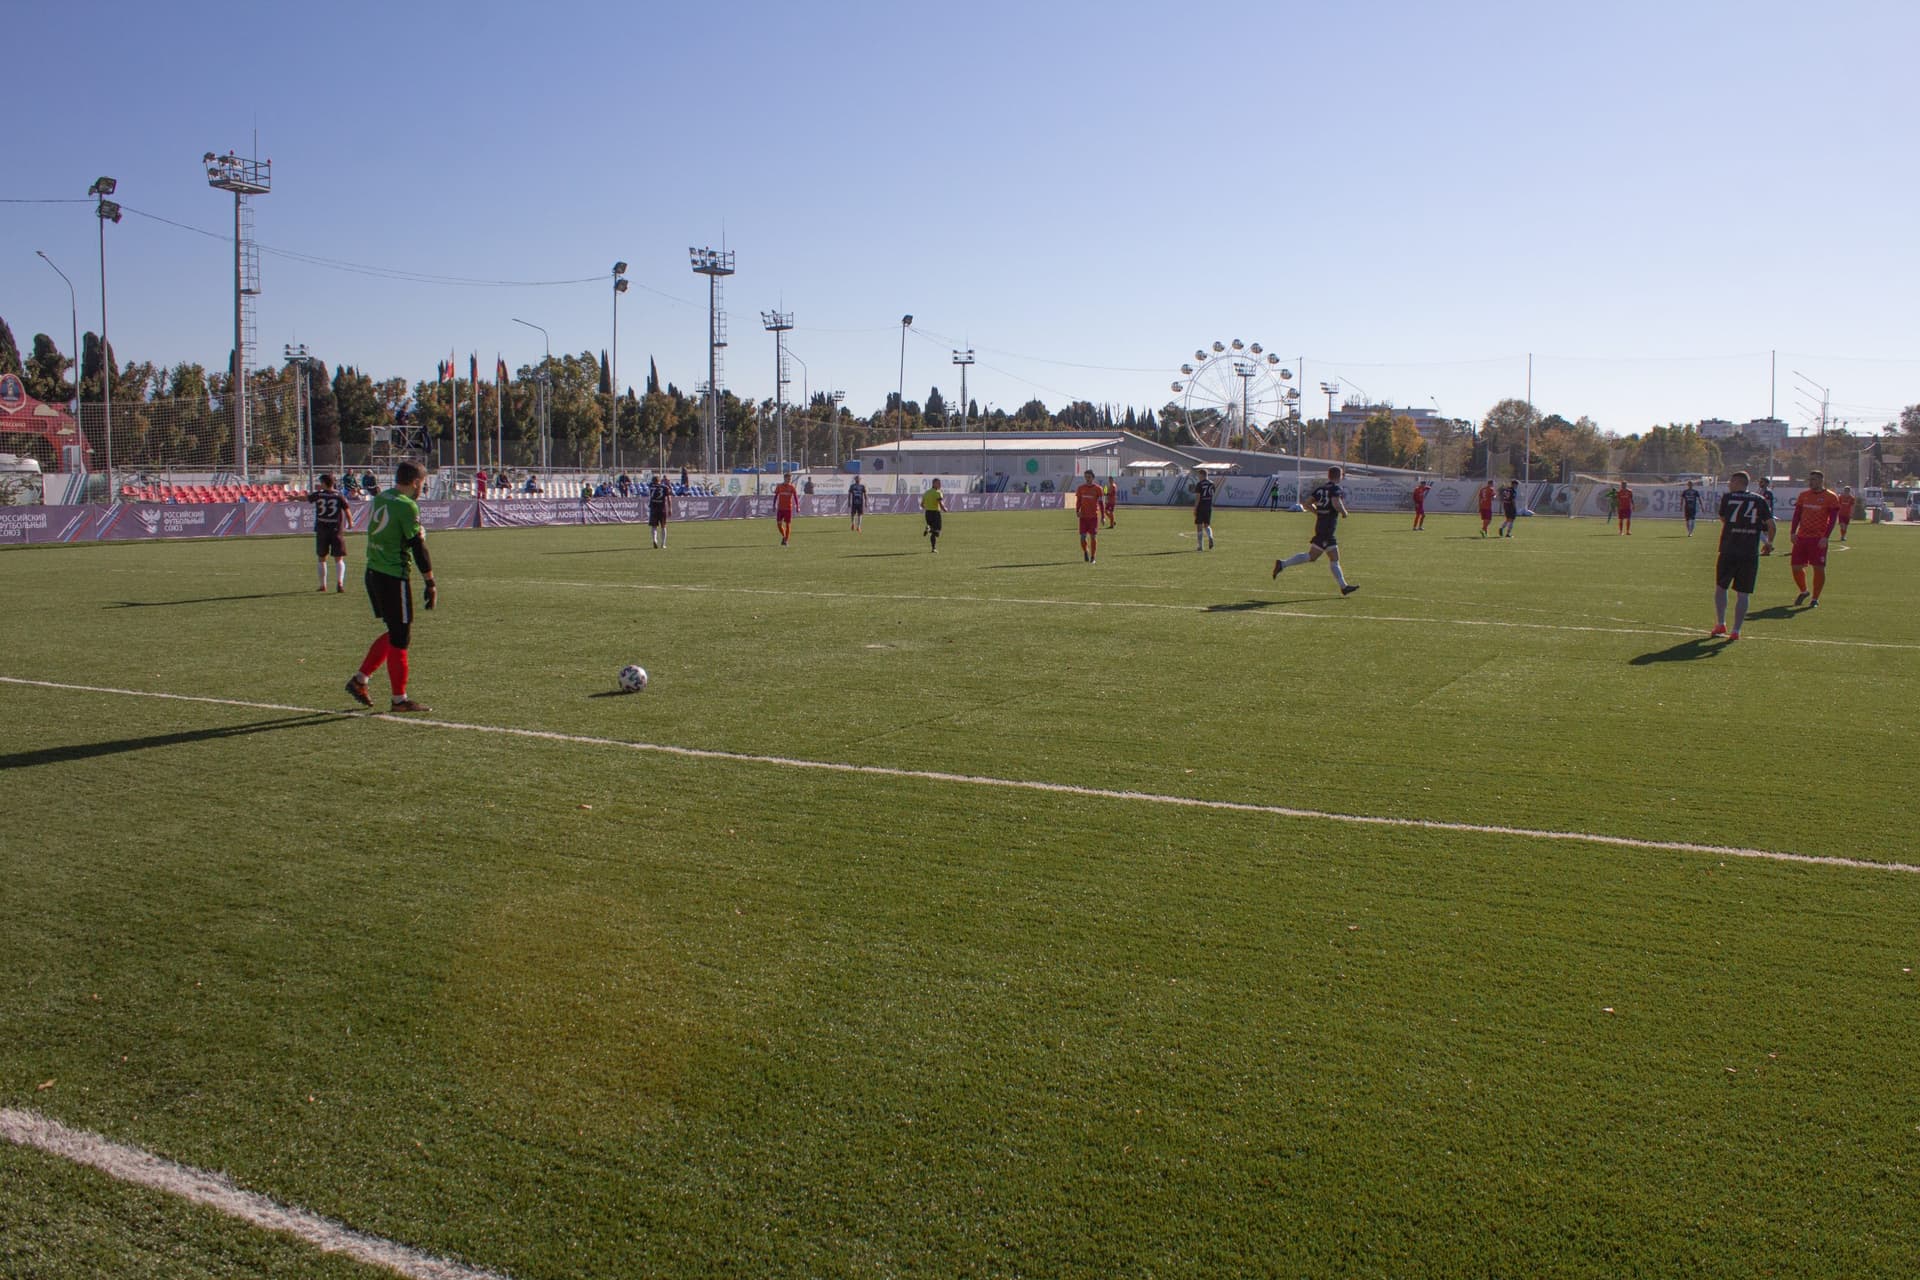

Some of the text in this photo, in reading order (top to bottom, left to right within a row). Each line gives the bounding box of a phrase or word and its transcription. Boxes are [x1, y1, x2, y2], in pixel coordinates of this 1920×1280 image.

[317, 498, 338, 517] 33
[1652, 488, 1665, 512] 3
[0, 513, 47, 521] ОССИЙСКИЙ
[1727, 500, 1758, 524] 74
